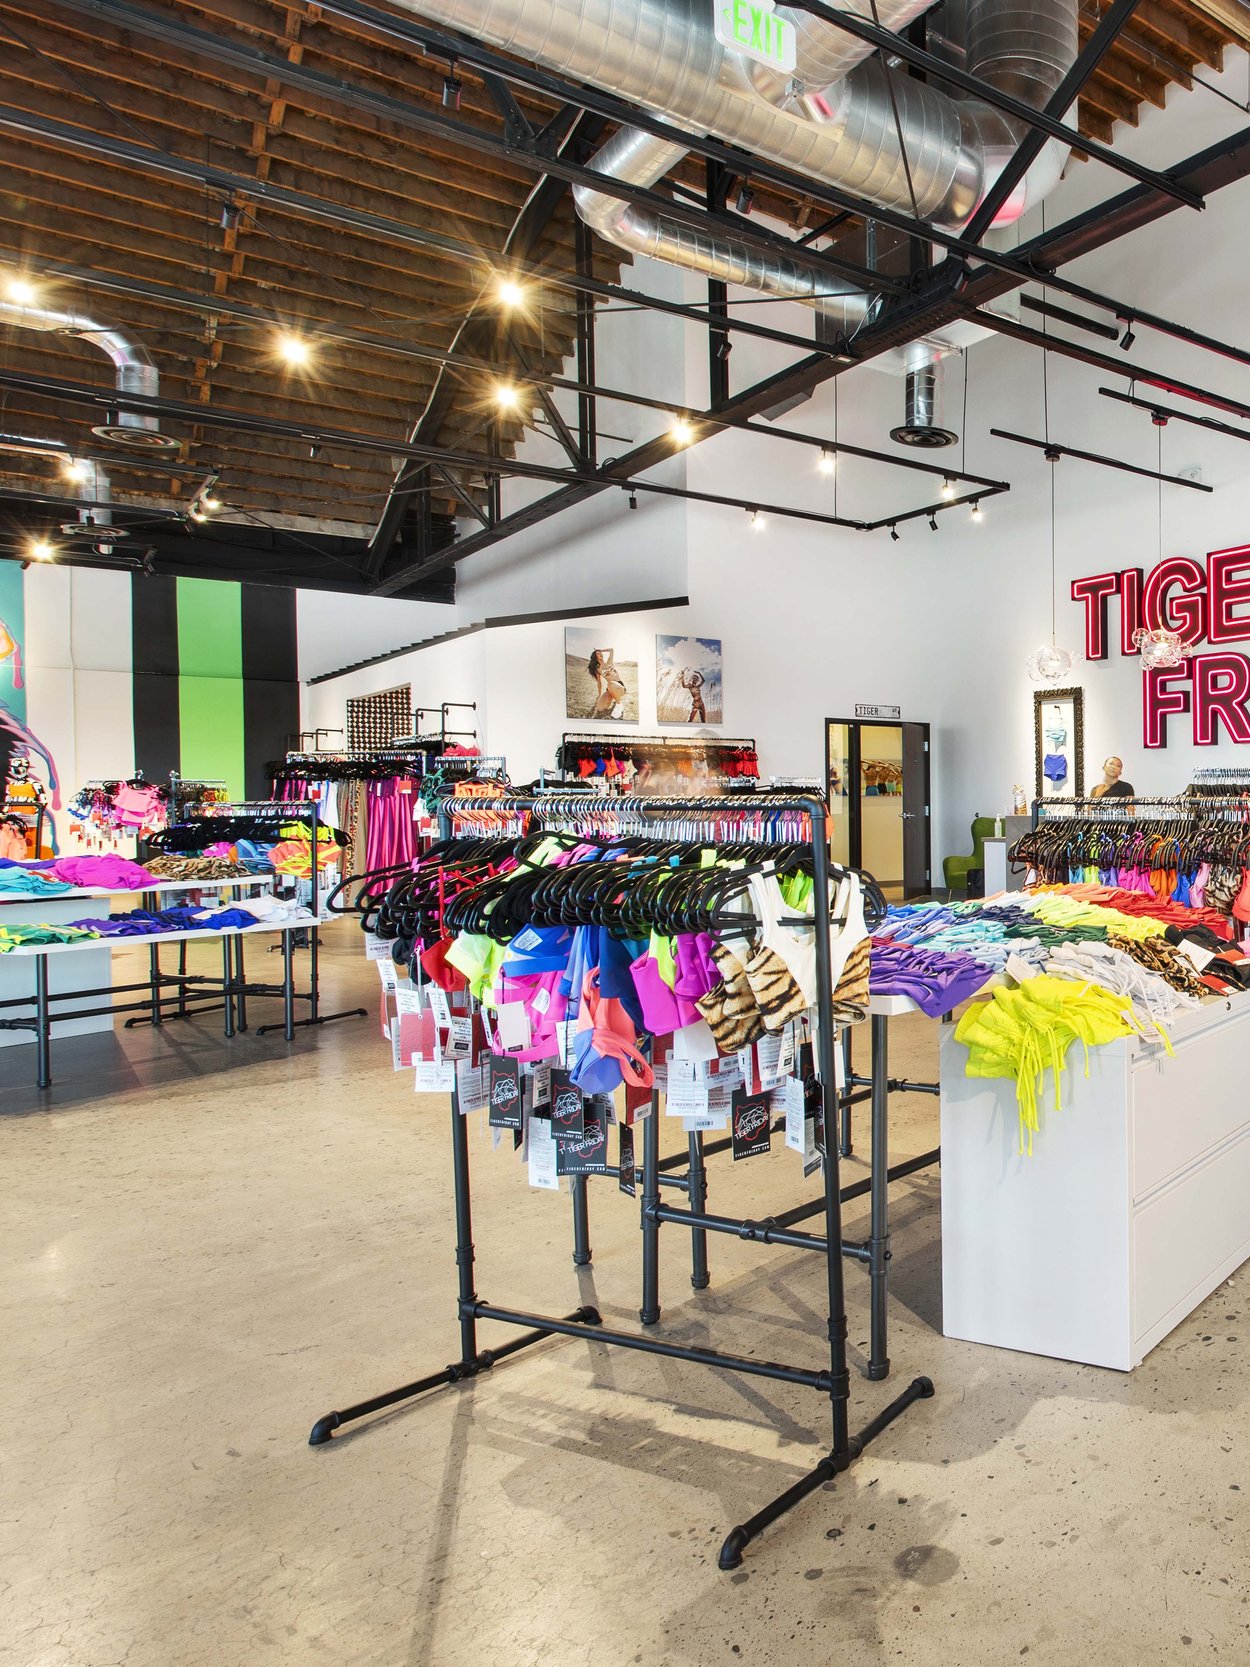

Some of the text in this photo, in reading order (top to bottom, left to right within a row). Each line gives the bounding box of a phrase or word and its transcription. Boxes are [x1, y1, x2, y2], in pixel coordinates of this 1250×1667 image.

[733, 0, 787, 63] EXIT
[859, 706, 879, 716] TIGER
[734, 1126, 750, 1140] TIGER
[567, 1139, 585, 1154] TIGER
[584, 1134, 605, 1148] FRIDAY
